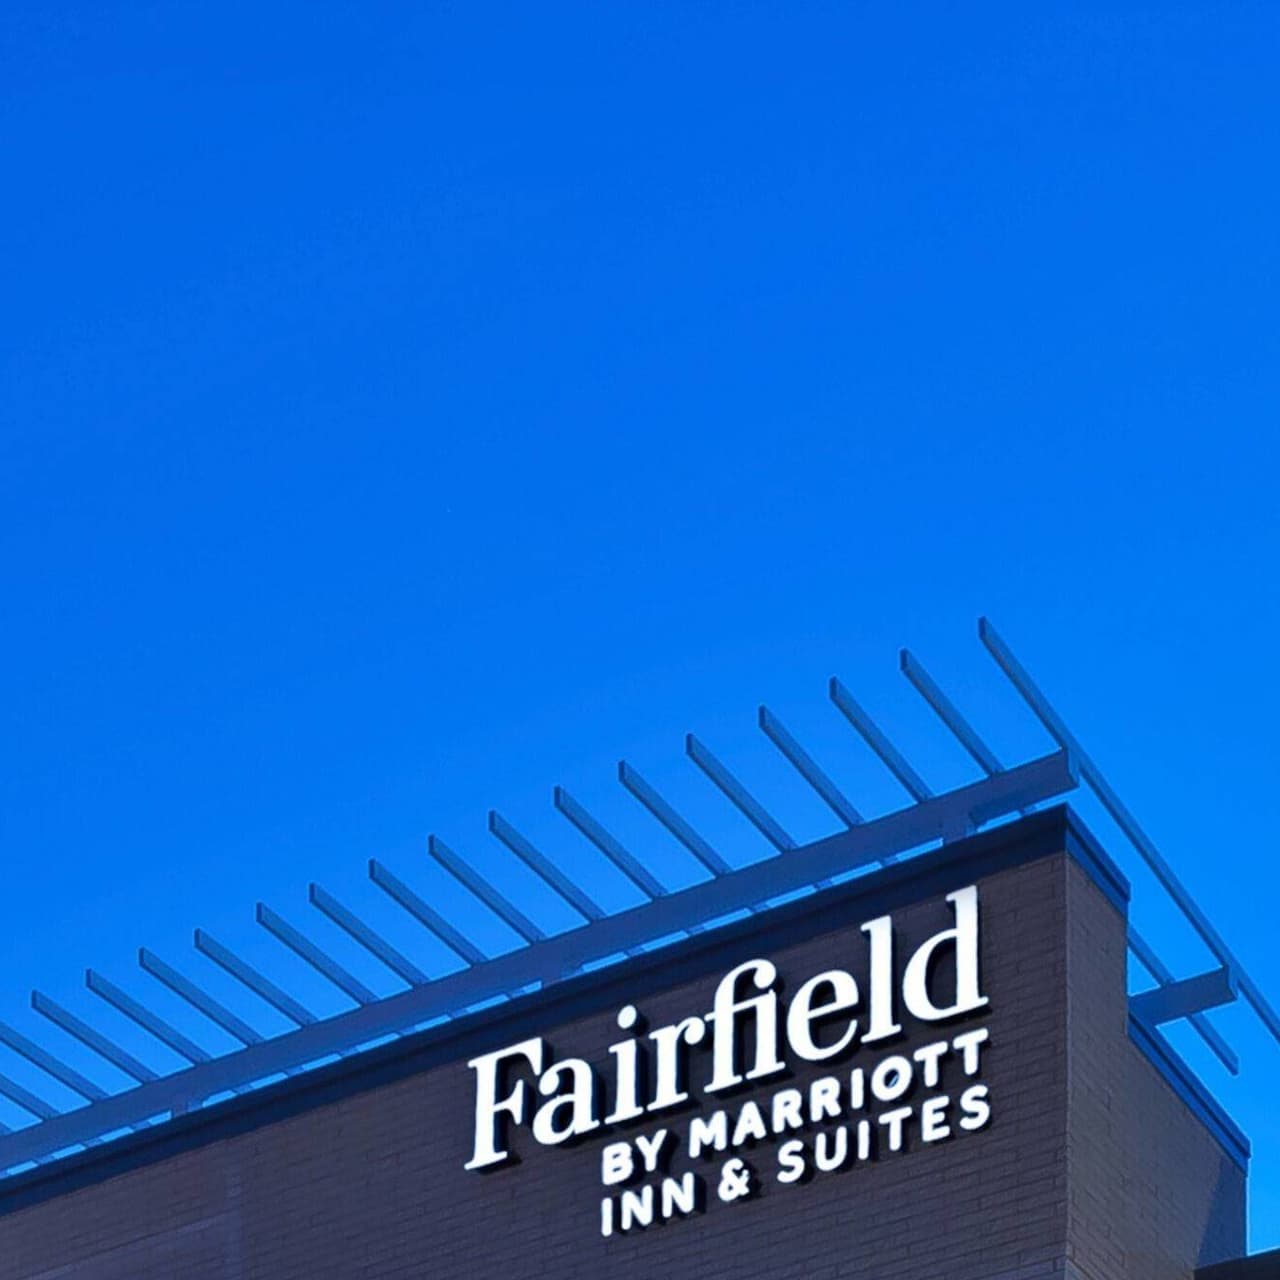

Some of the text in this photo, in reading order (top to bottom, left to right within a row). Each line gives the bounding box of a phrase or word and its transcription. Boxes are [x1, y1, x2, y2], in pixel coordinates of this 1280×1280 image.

[463, 884, 990, 1171] Fairfield
[601, 1027, 990, 1187] BY MARRIOTT
[600, 1083, 992, 1238] INN & SUITES
